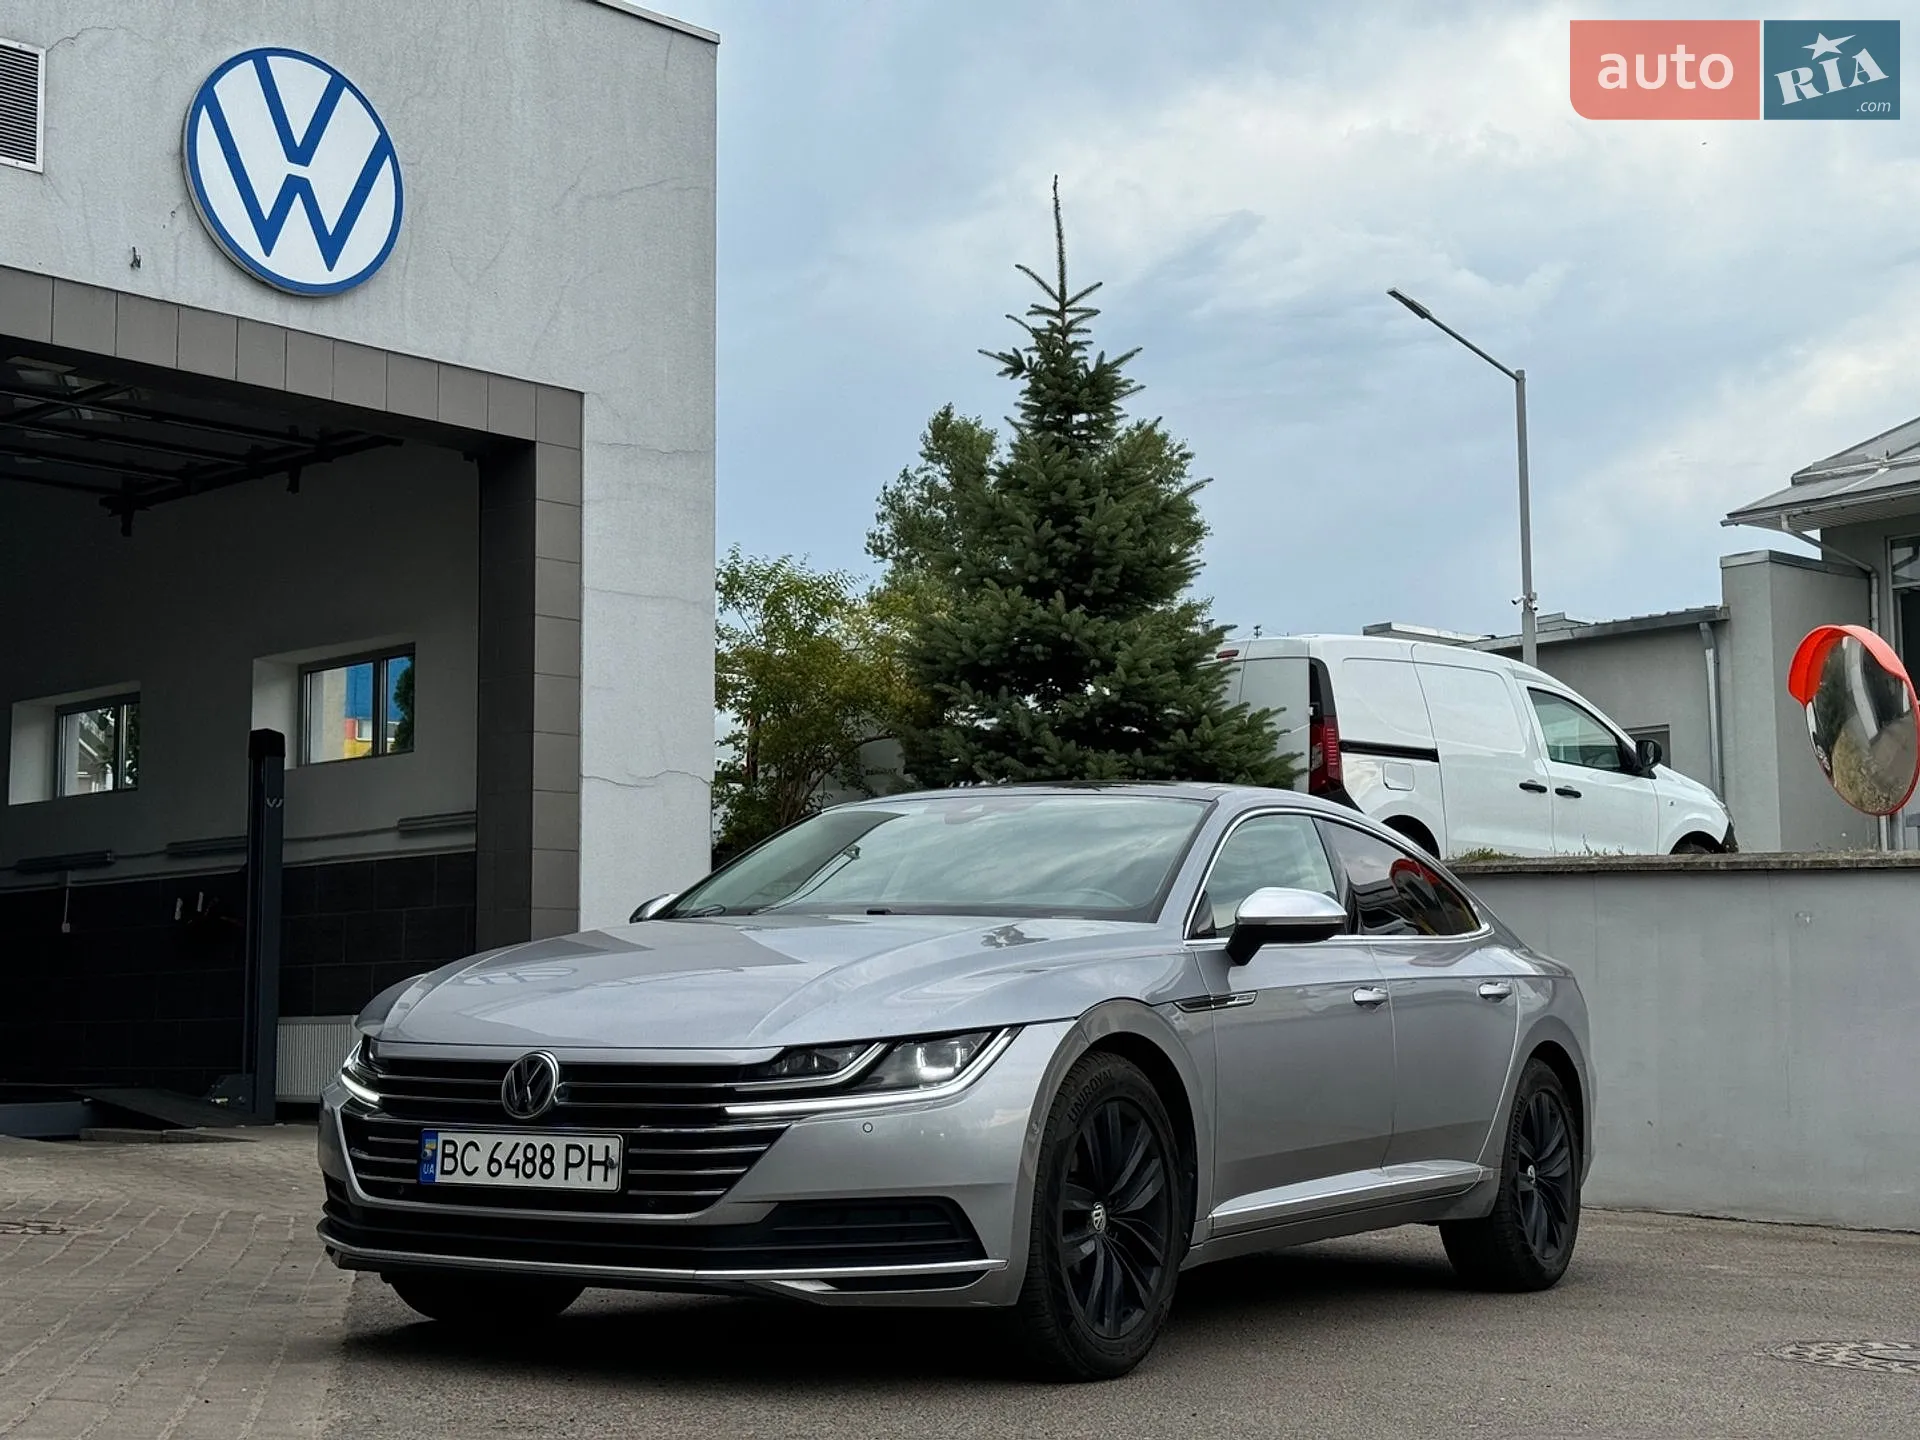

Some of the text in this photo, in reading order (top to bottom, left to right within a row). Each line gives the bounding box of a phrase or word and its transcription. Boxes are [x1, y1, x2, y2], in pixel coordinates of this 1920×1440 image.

[190, 49, 401, 282] VW
[1067, 1068, 1113, 1122] UNIROYAL
[422, 1163, 435, 1175] UA
[440, 1139, 611, 1182] BC 6488 PH
